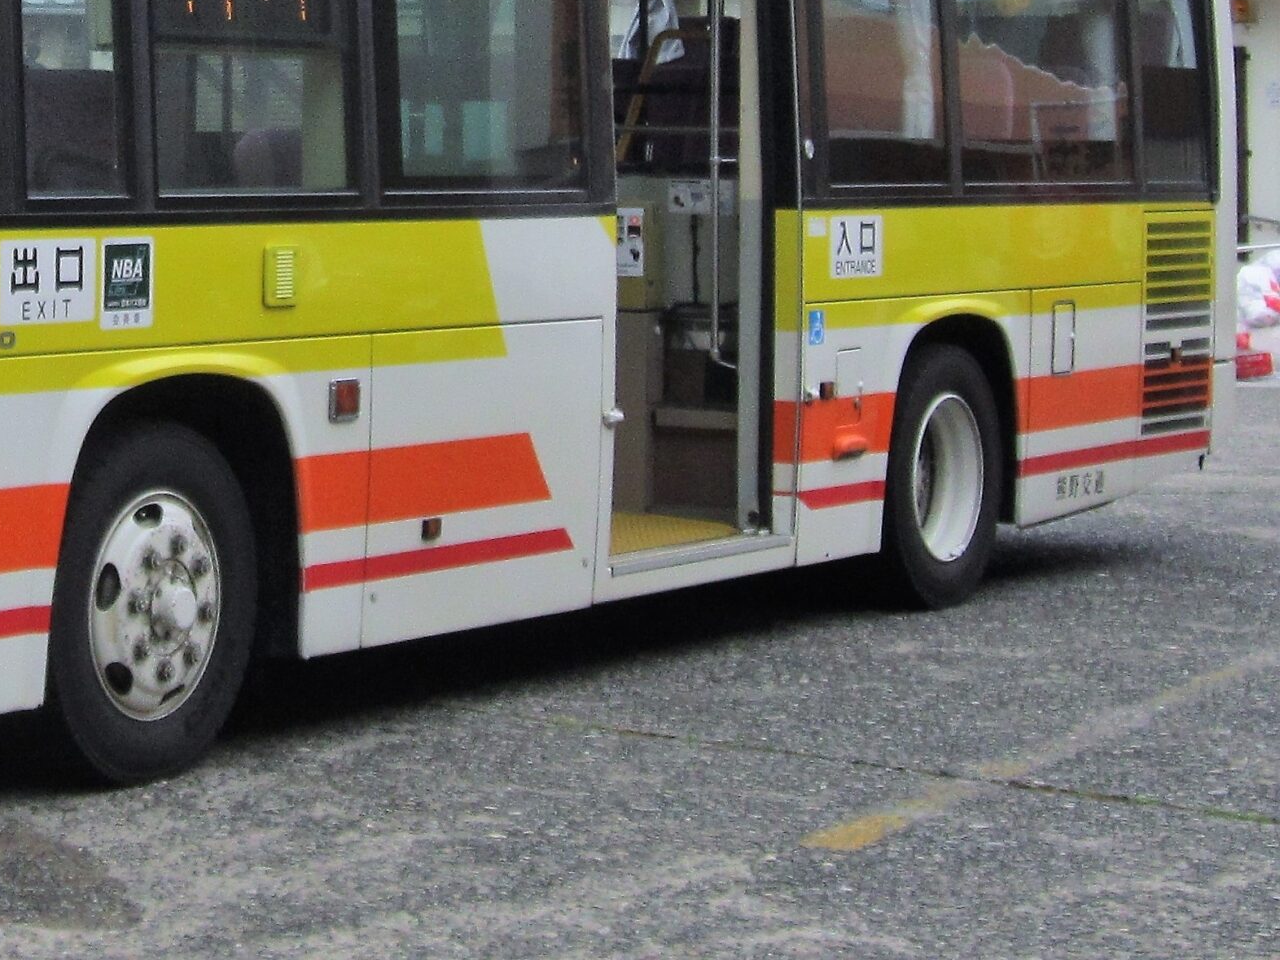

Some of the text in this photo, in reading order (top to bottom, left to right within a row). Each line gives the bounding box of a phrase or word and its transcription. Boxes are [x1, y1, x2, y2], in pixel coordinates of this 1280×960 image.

[836, 220, 876, 255] 入口
[10, 246, 84, 295] 出口
[111, 258, 144, 280] NBA
[834, 259, 877, 276] ENTRANCE
[21, 299, 72, 321] EXIT
